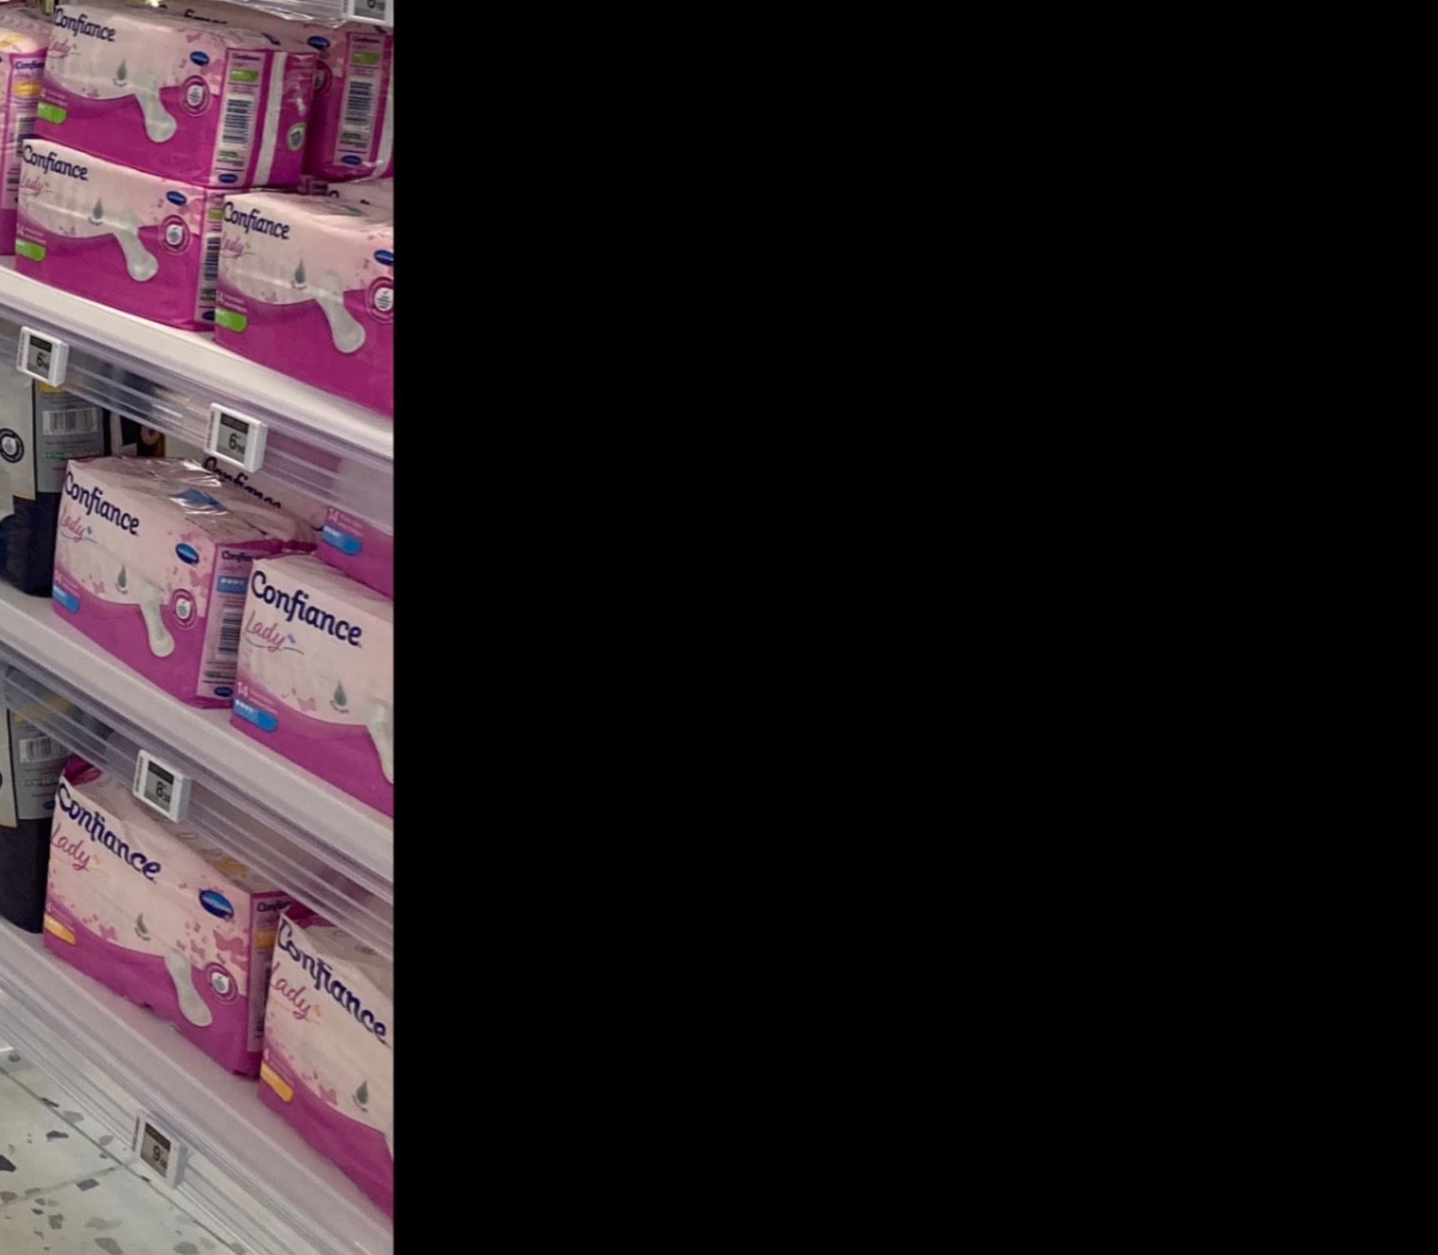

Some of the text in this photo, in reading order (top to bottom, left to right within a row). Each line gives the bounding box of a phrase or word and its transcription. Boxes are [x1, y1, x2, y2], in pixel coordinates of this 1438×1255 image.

[54, 8, 116, 43] Confiance
[23, 145, 89, 182] Confiance
[223, 201, 291, 241] Confiance
[59, 503, 87, 544] Lady
[64, 469, 141, 537] Confiance
[244, 609, 288, 654] Lady
[250, 570, 363, 648] Confiance
[236, 681, 250, 698] 14
[51, 821, 92, 872] Lady
[54, 781, 162, 884] Confiance
[268, 961, 313, 1022] Lady
[277, 920, 388, 1045] Confiance
